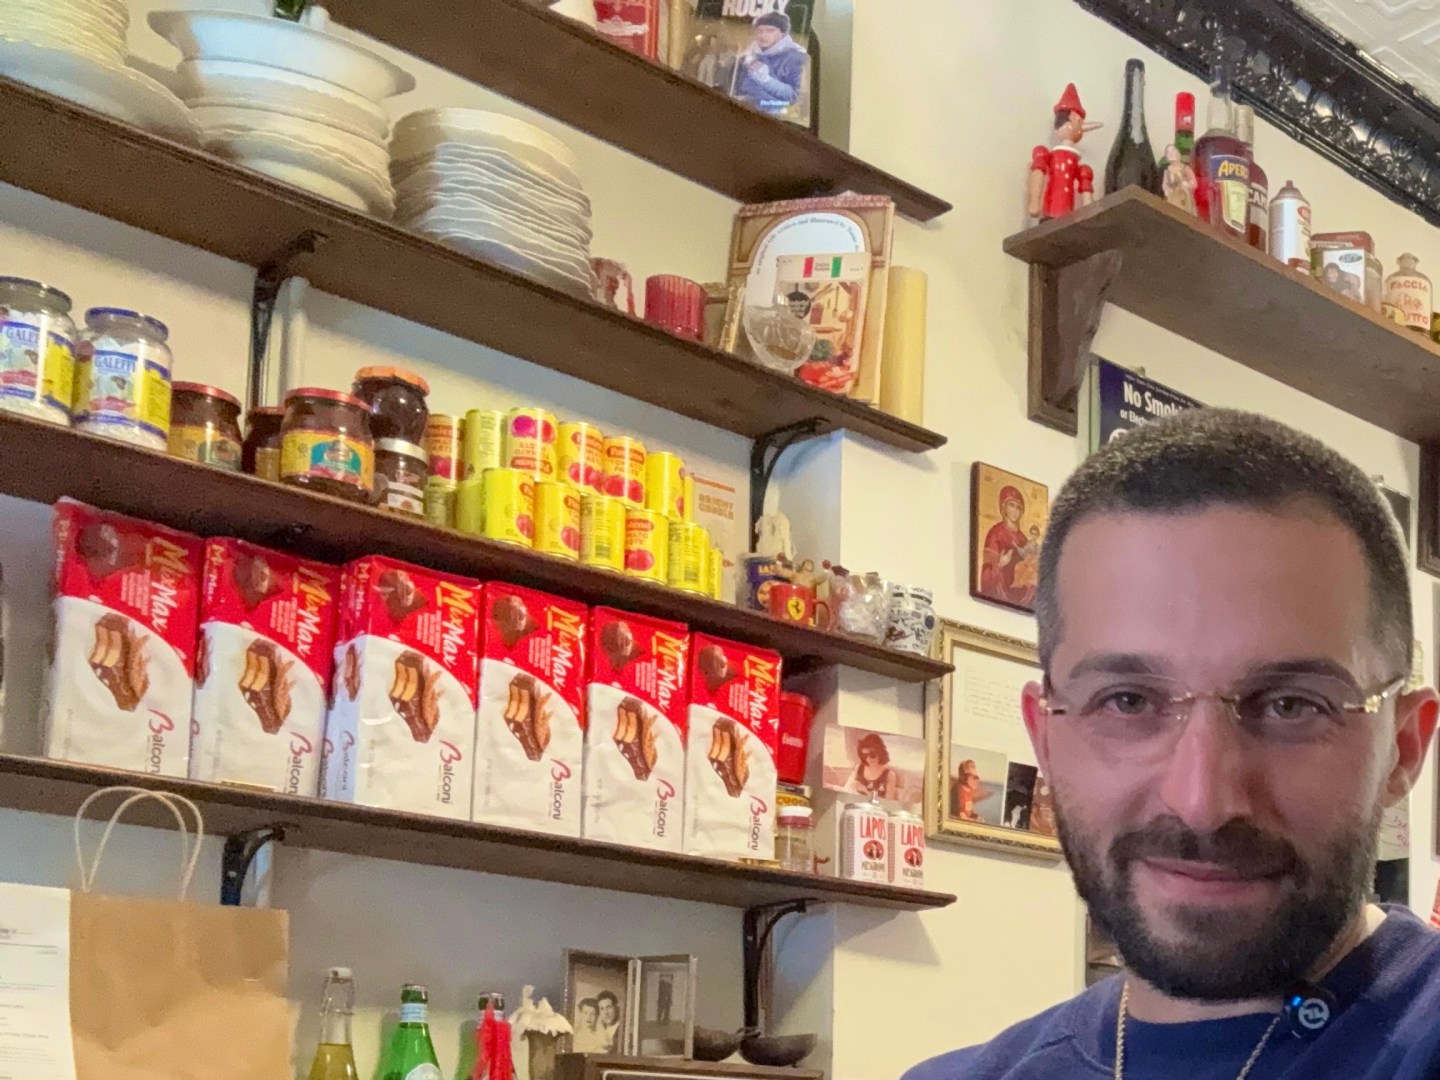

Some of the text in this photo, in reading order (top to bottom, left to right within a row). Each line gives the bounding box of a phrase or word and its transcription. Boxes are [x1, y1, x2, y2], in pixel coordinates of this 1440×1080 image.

[1390, 280, 1428, 293] FACCIA
[95, 355, 136, 374] GALEFFI
[1123, 381, 1142, 408] No
[147, 708, 175, 774] Balcon
[287, 731, 313, 795] Balcon
[437, 740, 462, 805] Balconi
[549, 758, 572, 821] Balconi
[656, 778, 676, 838] Balconi
[749, 796, 768, 851] Balconi
